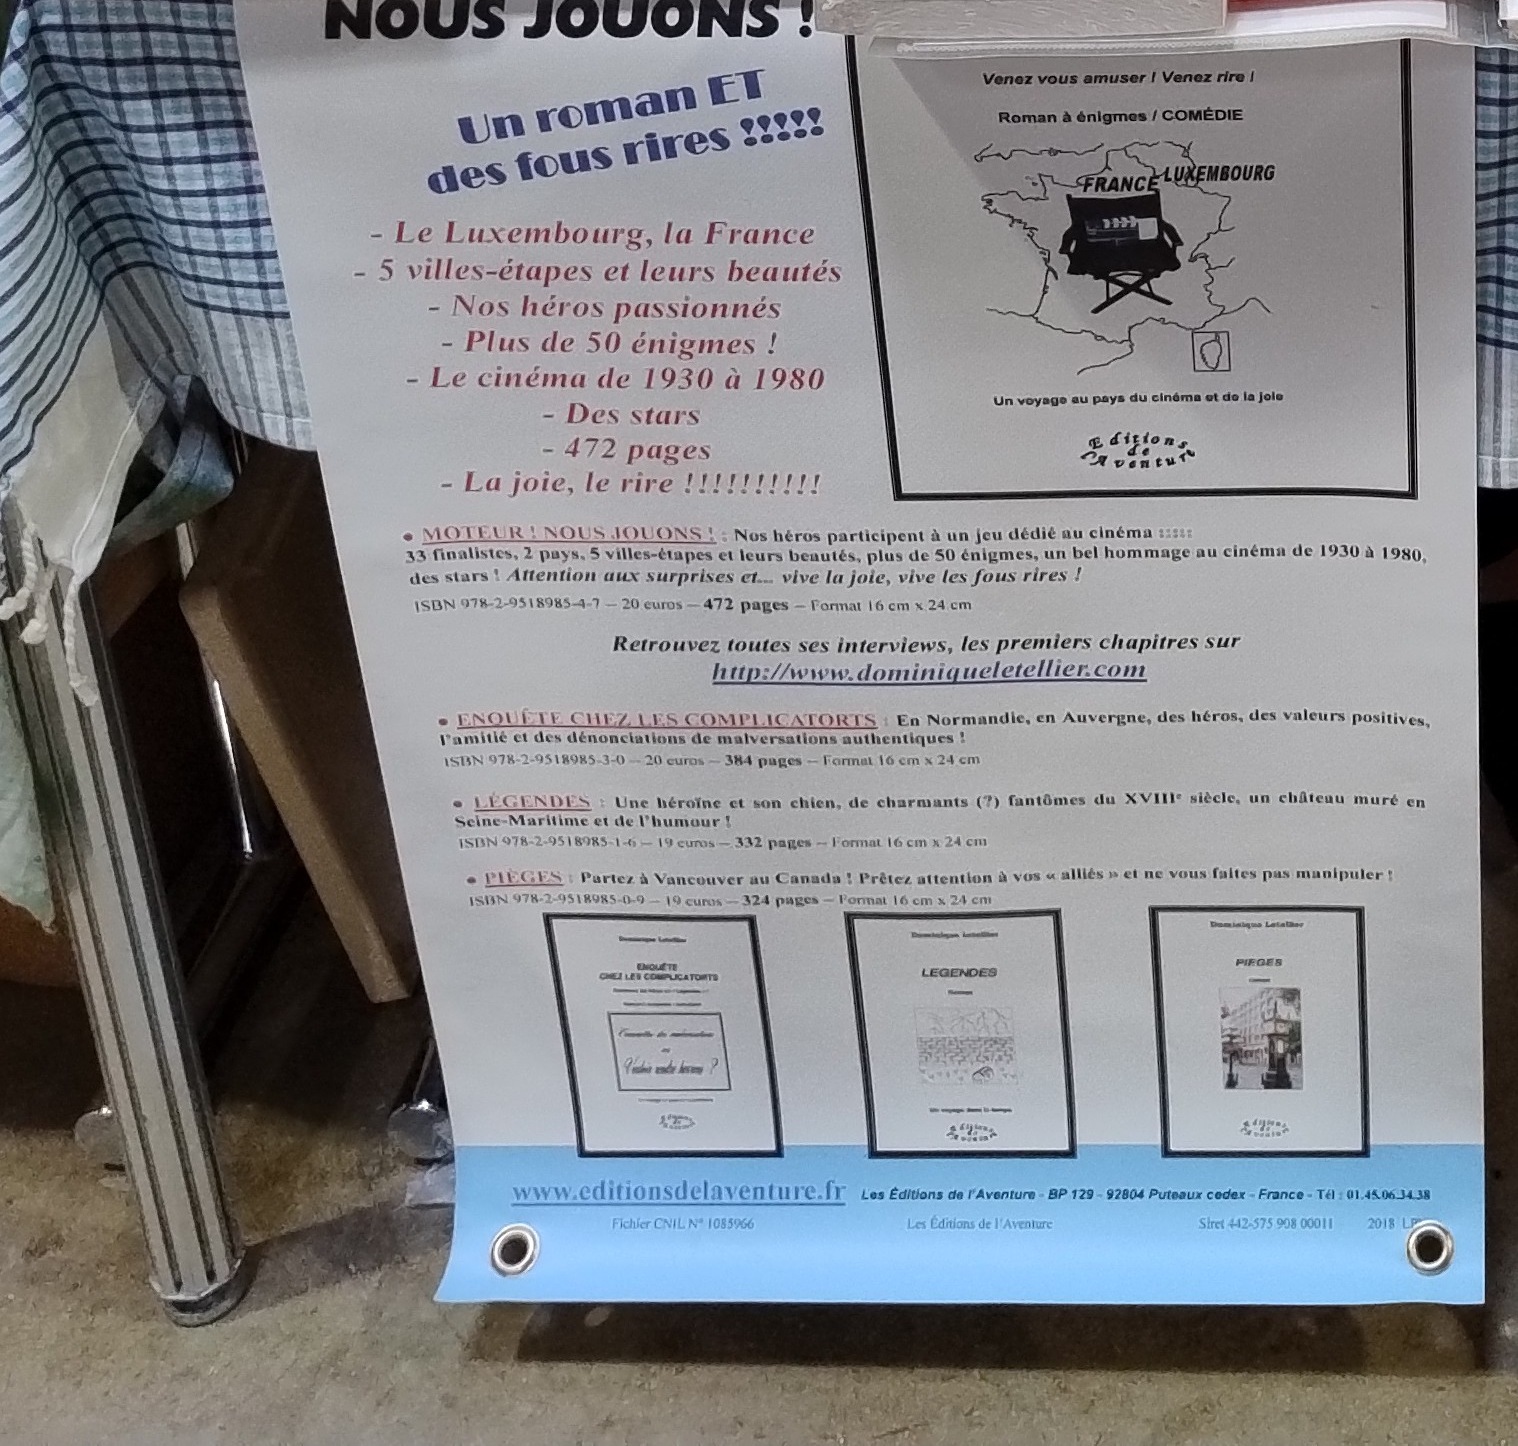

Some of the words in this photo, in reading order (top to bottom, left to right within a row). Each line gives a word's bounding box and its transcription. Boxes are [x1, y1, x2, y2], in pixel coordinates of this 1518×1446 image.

[457, 113, 525, 144] Un
[535, 86, 696, 132] roman
[707, 68, 764, 105] ET
[998, 111, 1057, 123] Roman
[1062, 110, 1072, 122] à
[1076, 110, 1147, 125] énigmes
[1161, 106, 1243, 121] COMÉDIE
[427, 162, 507, 194] des
[514, 146, 612, 181] fous
[622, 127, 730, 165] rires
[452, 294, 508, 316] Nos
[521, 294, 603, 317] héros
[612, 295, 781, 324] passionnés
[566, 402, 618, 424] Des
[630, 407, 699, 425] stars
[564, 436, 615, 458] 472
[626, 444, 710, 465] pages
[613, 635, 720, 653] Retrouvez
[727, 638, 790, 652] toutes
[798, 641, 829, 653] ses
[837, 636, 952, 654] interviews,
[961, 635, 989, 651] les
[995, 632, 1091, 655] premiers
[1099, 633, 1198, 654] chapitres
[1204, 636, 1241, 648] sur
[711, 658, 1147, 684] http://www.dominiqueletellier.com
[1235, 957, 1282, 966] PIEGES
[510, 1179, 846, 1206] www.editionsdelaventure.fr
